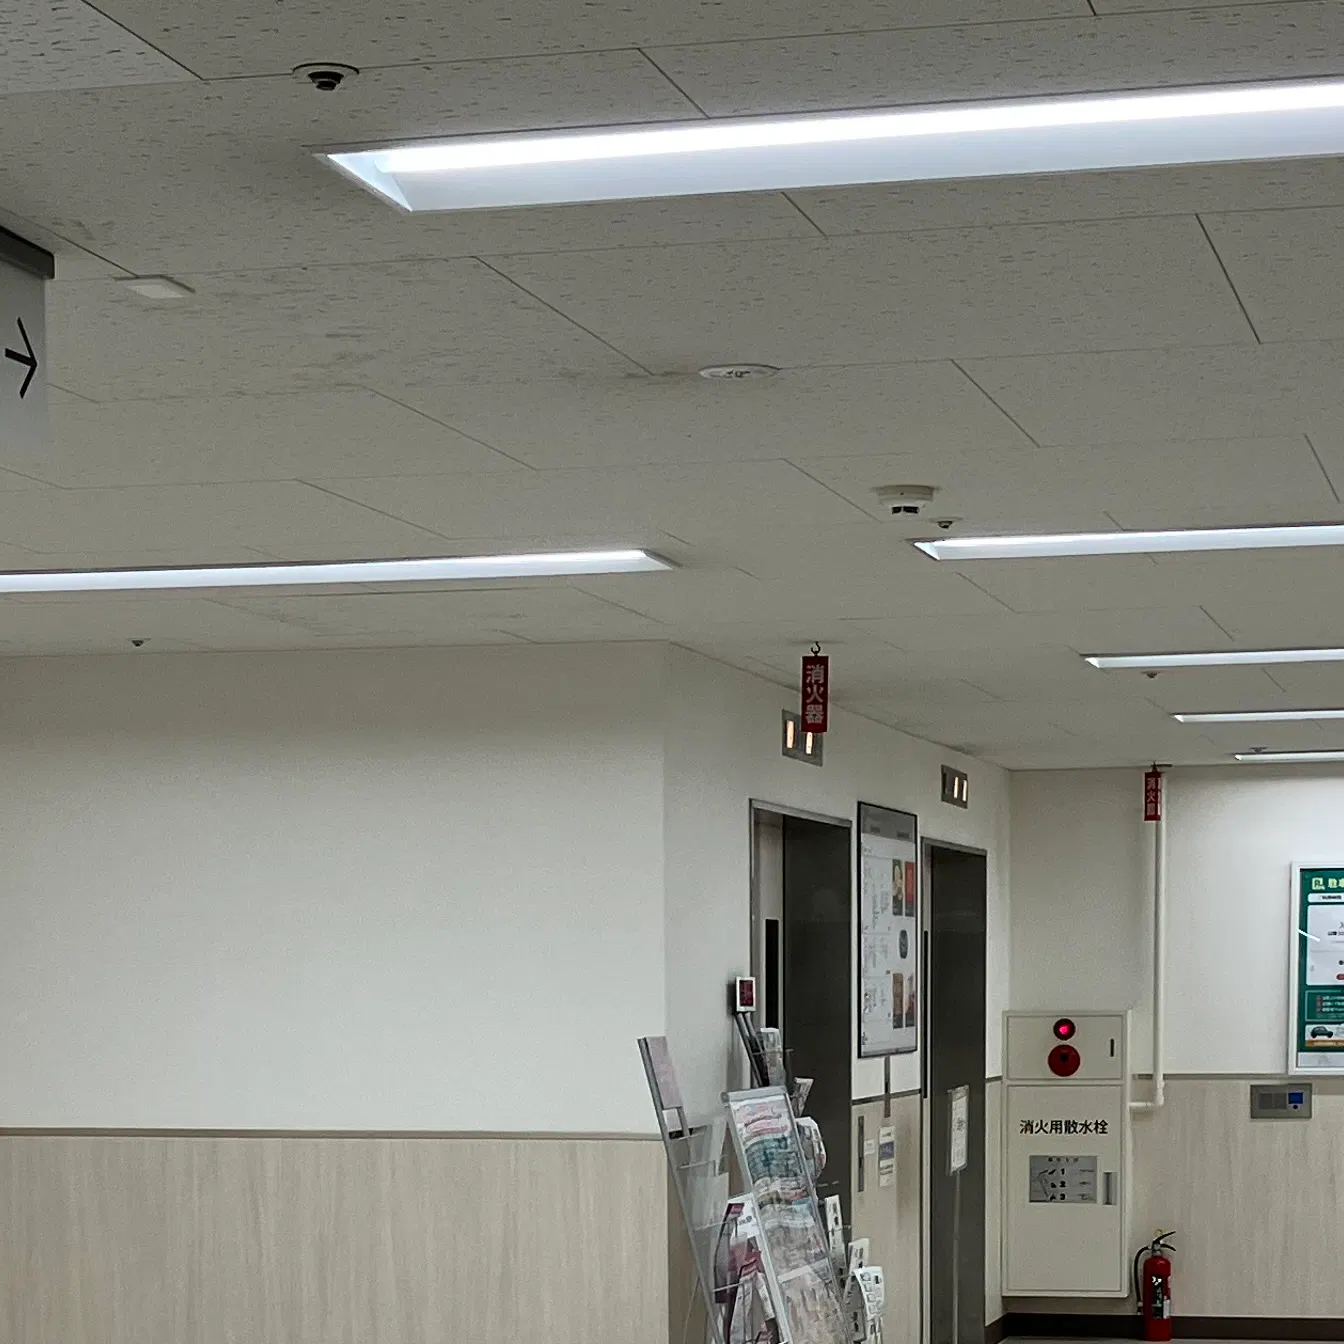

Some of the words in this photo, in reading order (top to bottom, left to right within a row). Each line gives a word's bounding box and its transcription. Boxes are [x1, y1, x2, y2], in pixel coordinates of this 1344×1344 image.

[805, 664, 825, 725] 消火器
[1019, 1119, 1109, 1135] 消火用散水栓
